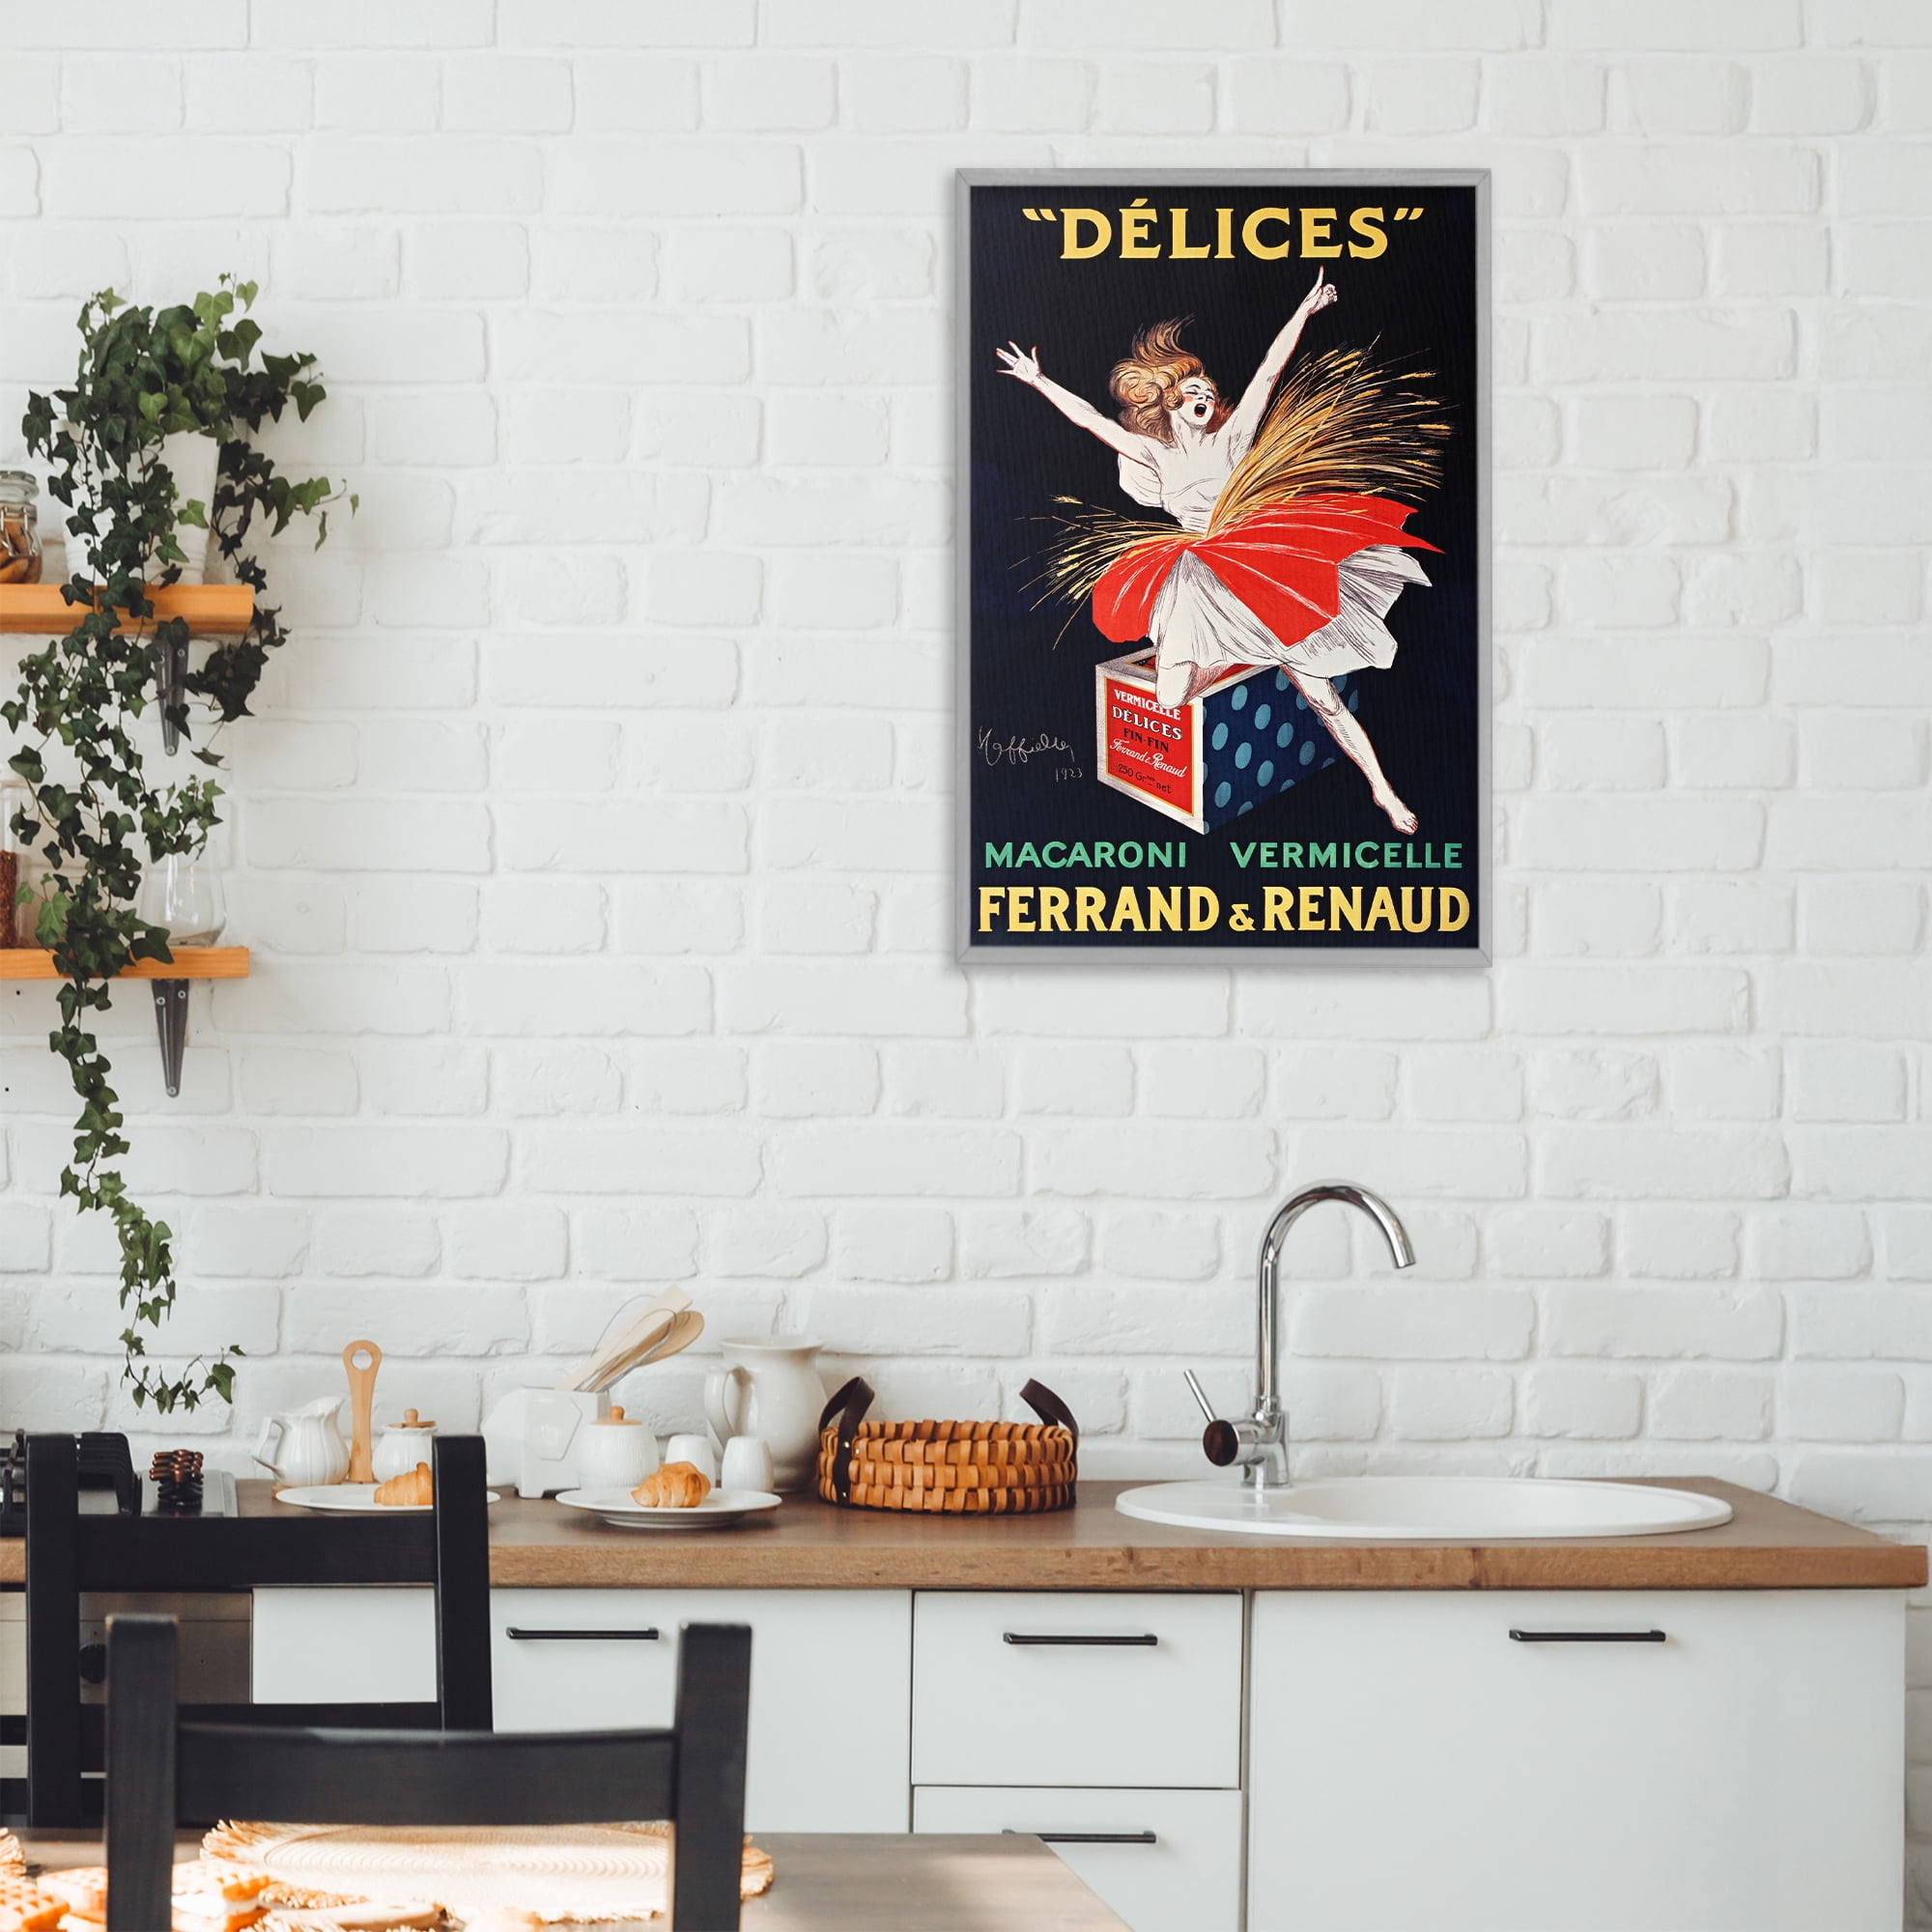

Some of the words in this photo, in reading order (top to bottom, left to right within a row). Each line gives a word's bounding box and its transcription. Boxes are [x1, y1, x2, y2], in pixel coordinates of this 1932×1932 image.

[1114, 689, 1181, 721] VERMICELLE
[1112, 705, 1183, 741] DÉLICES
[1109, 738, 1148, 762] Ferrand
[1150, 753, 1188, 778] Renaud
[1054, 767, 1083, 782] 1923
[1118, 763, 1134, 778] 250
[1156, 781, 1172, 794] net
[984, 840, 1186, 868] MACARONI
[1230, 840, 1463, 869] VERMICELLE
[978, 886, 1220, 932] FERRAND
[1228, 903, 1257, 932] &
[1262, 886, 1470, 933] RENAUD
